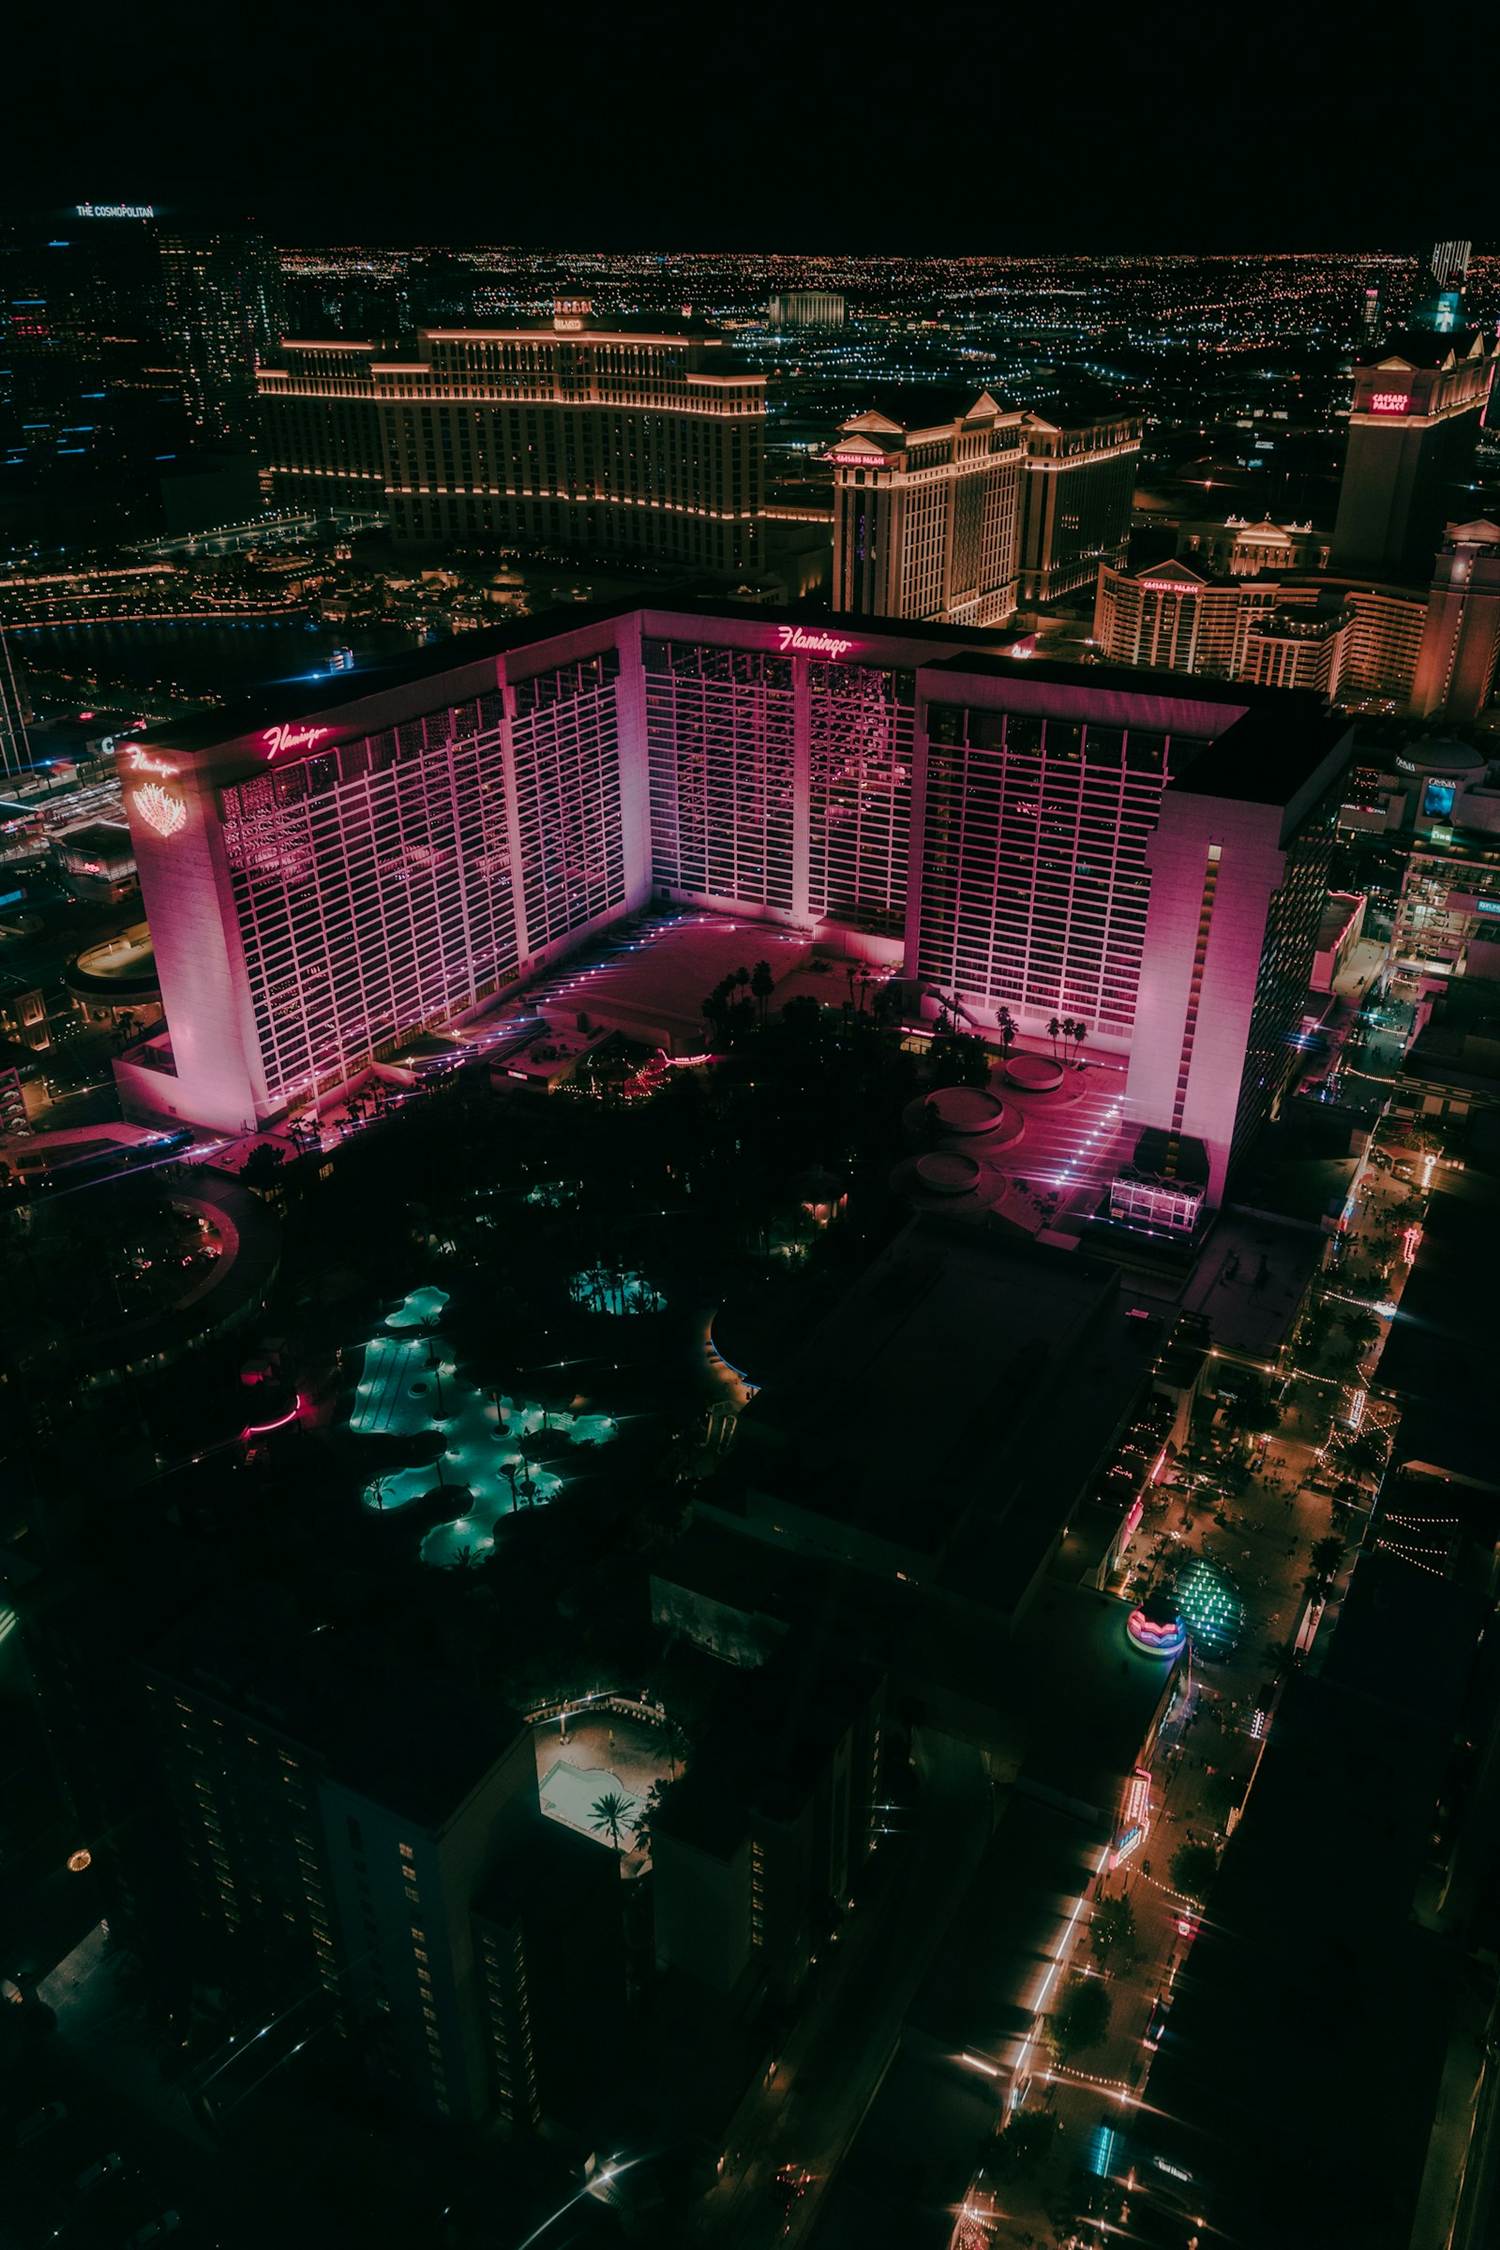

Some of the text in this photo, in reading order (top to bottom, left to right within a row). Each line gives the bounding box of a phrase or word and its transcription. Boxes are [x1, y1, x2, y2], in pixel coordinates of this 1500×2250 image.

[76, 205, 154, 218] THE COSMOPOLITAN
[1372, 394, 1408, 402] CAESARS
[778, 625, 852, 659] Flamingo
[262, 723, 328, 760] Flamingo
